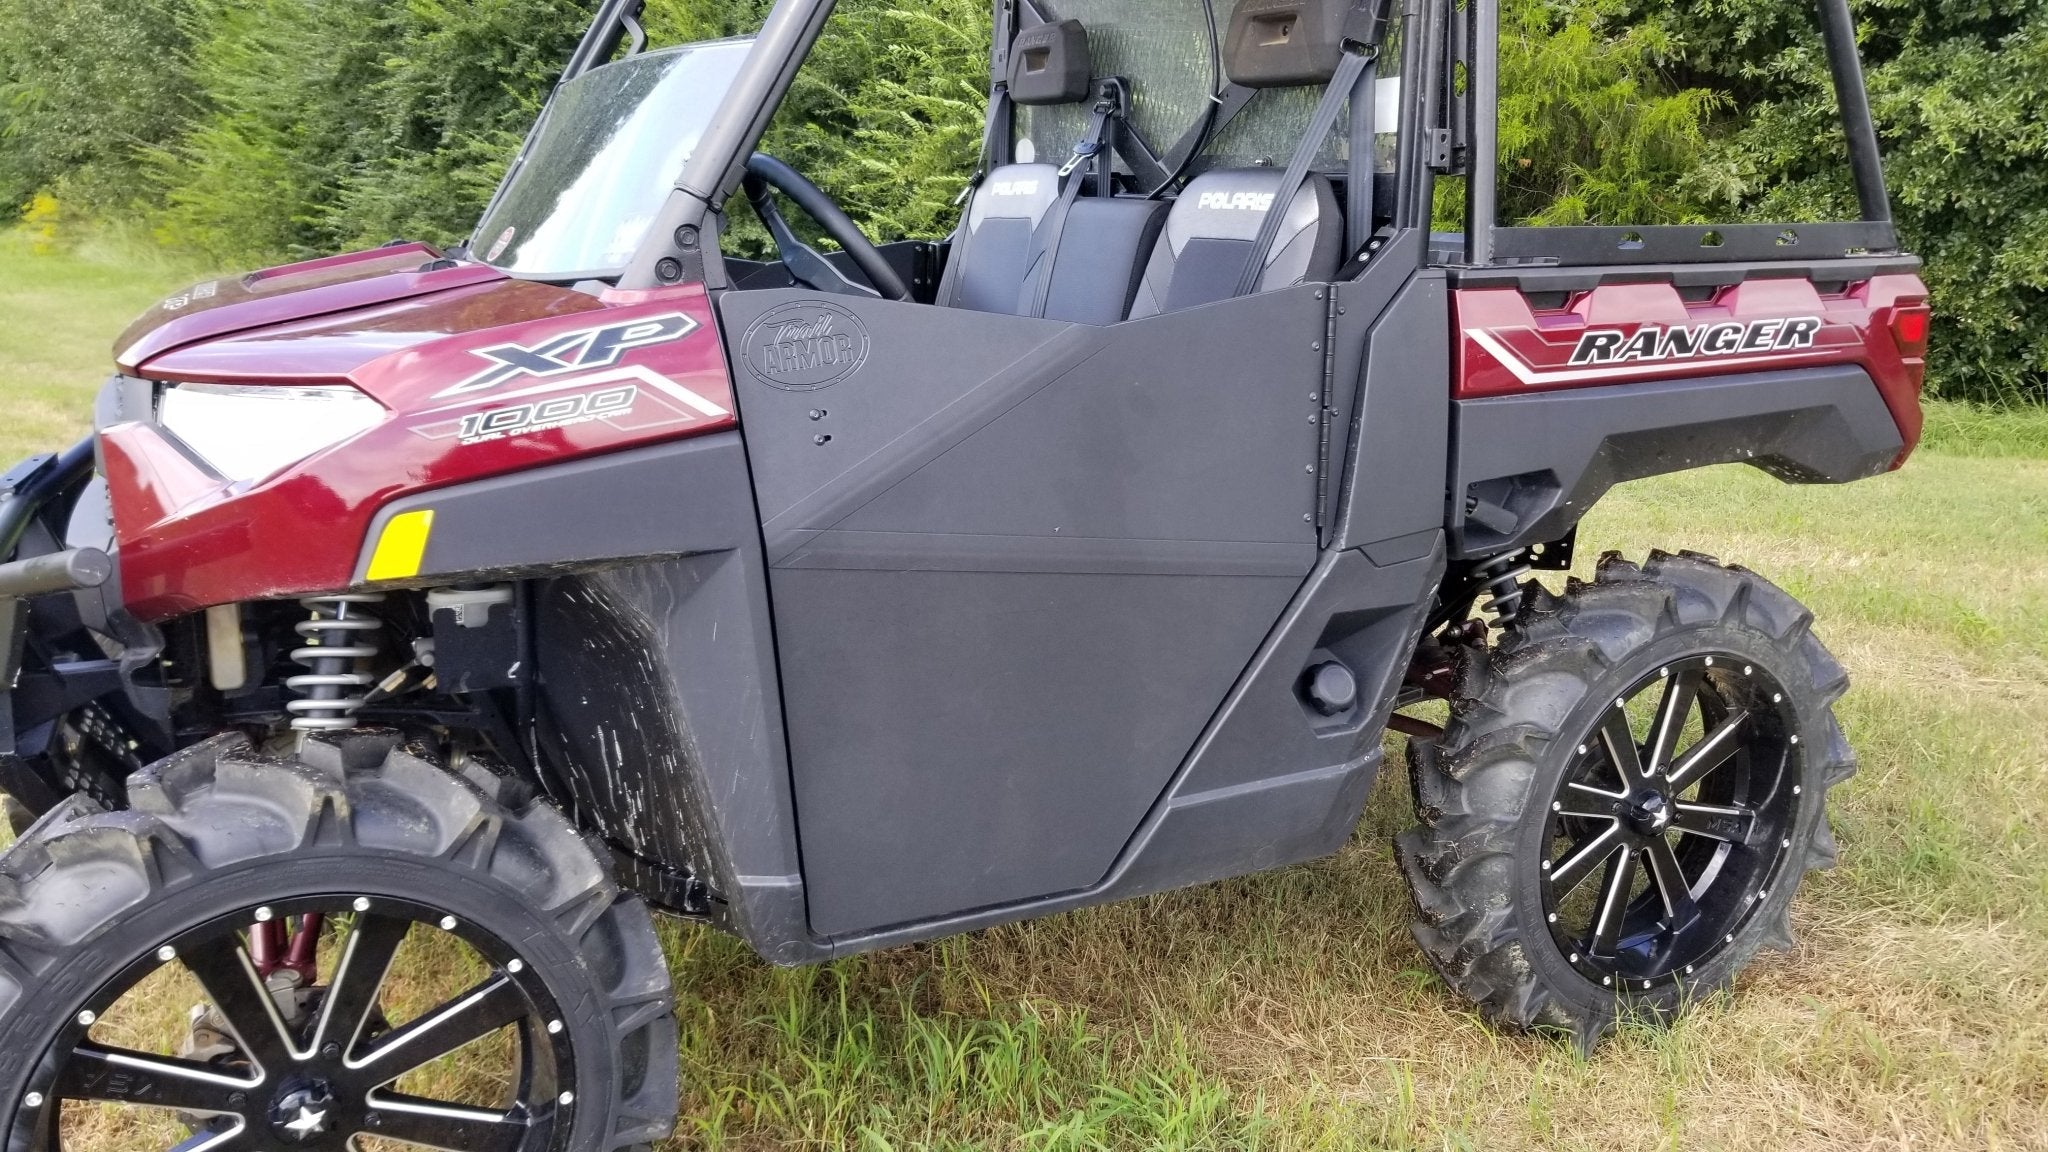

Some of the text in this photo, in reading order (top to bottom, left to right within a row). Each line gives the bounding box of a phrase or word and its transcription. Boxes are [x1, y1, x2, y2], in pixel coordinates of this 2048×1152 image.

[991, 180, 1039, 196] POLARIS
[1198, 192, 1275, 211] POLARIS
[430, 311, 702, 399] XP
[763, 334, 854, 375] ARMOR
[1567, 316, 1821, 366] RANGER
[458, 385, 638, 439] 1000
[461, 431, 507, 446] DUAL
